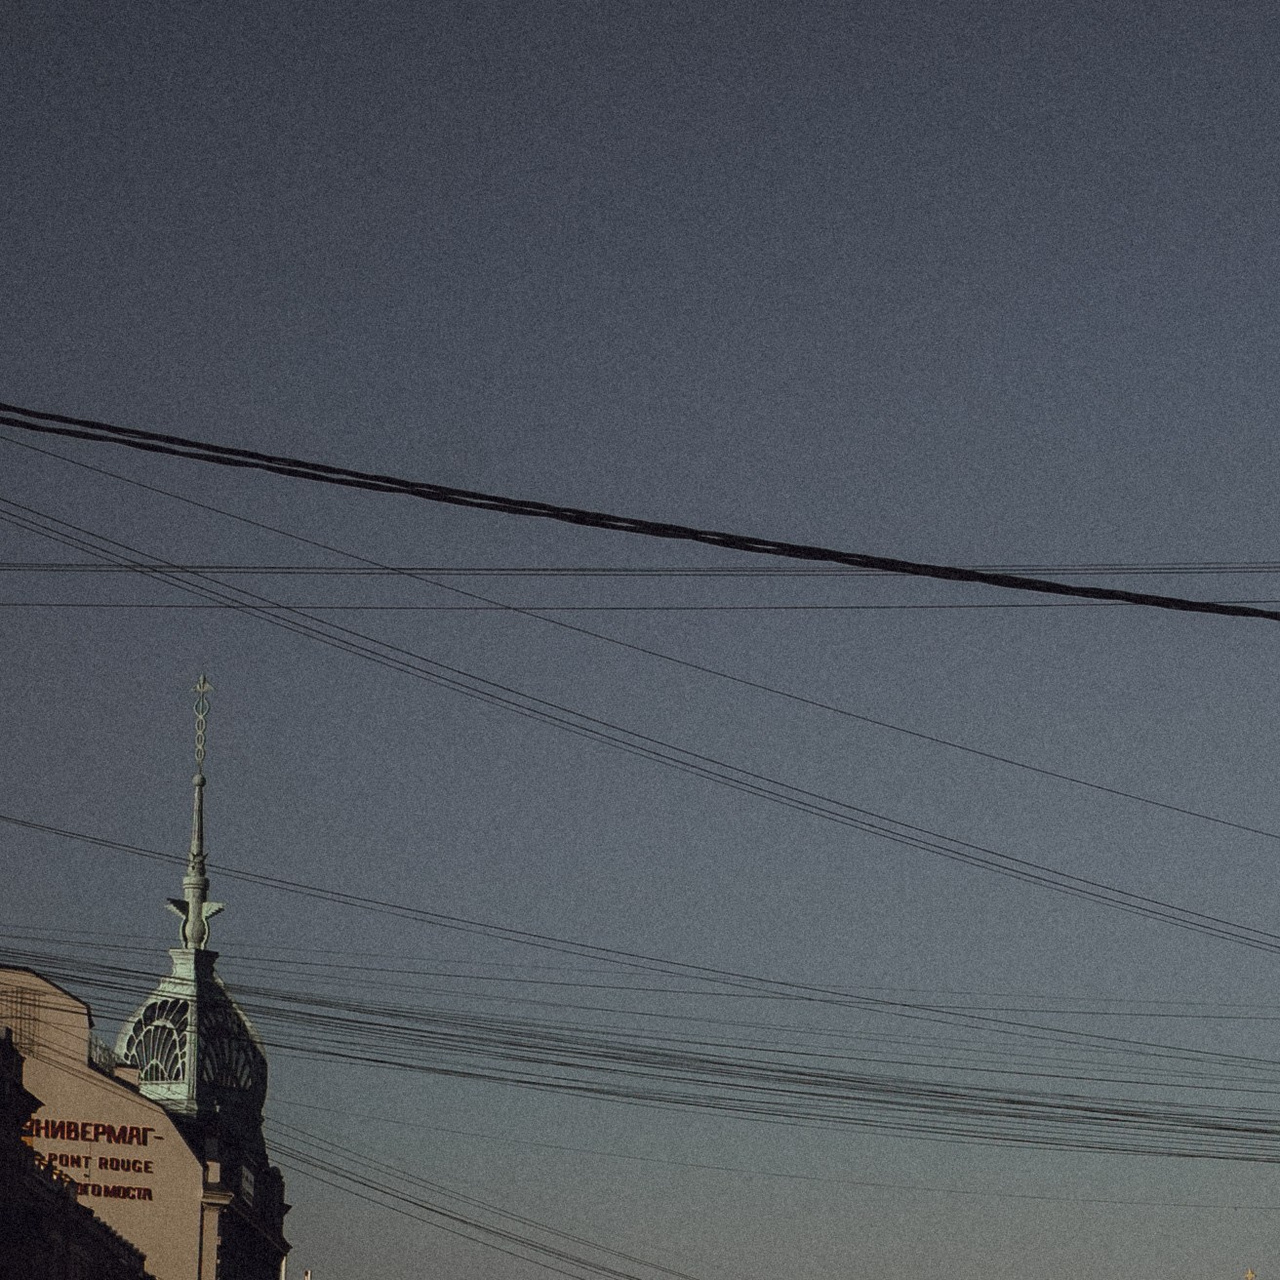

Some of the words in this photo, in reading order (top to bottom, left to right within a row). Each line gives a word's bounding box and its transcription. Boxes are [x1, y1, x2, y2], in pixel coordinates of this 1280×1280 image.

[47, 1152, 92, 1169] PONT
[98, 1156, 154, 1174] ROUGE
[103, 1184, 153, 1201] МОСТА
